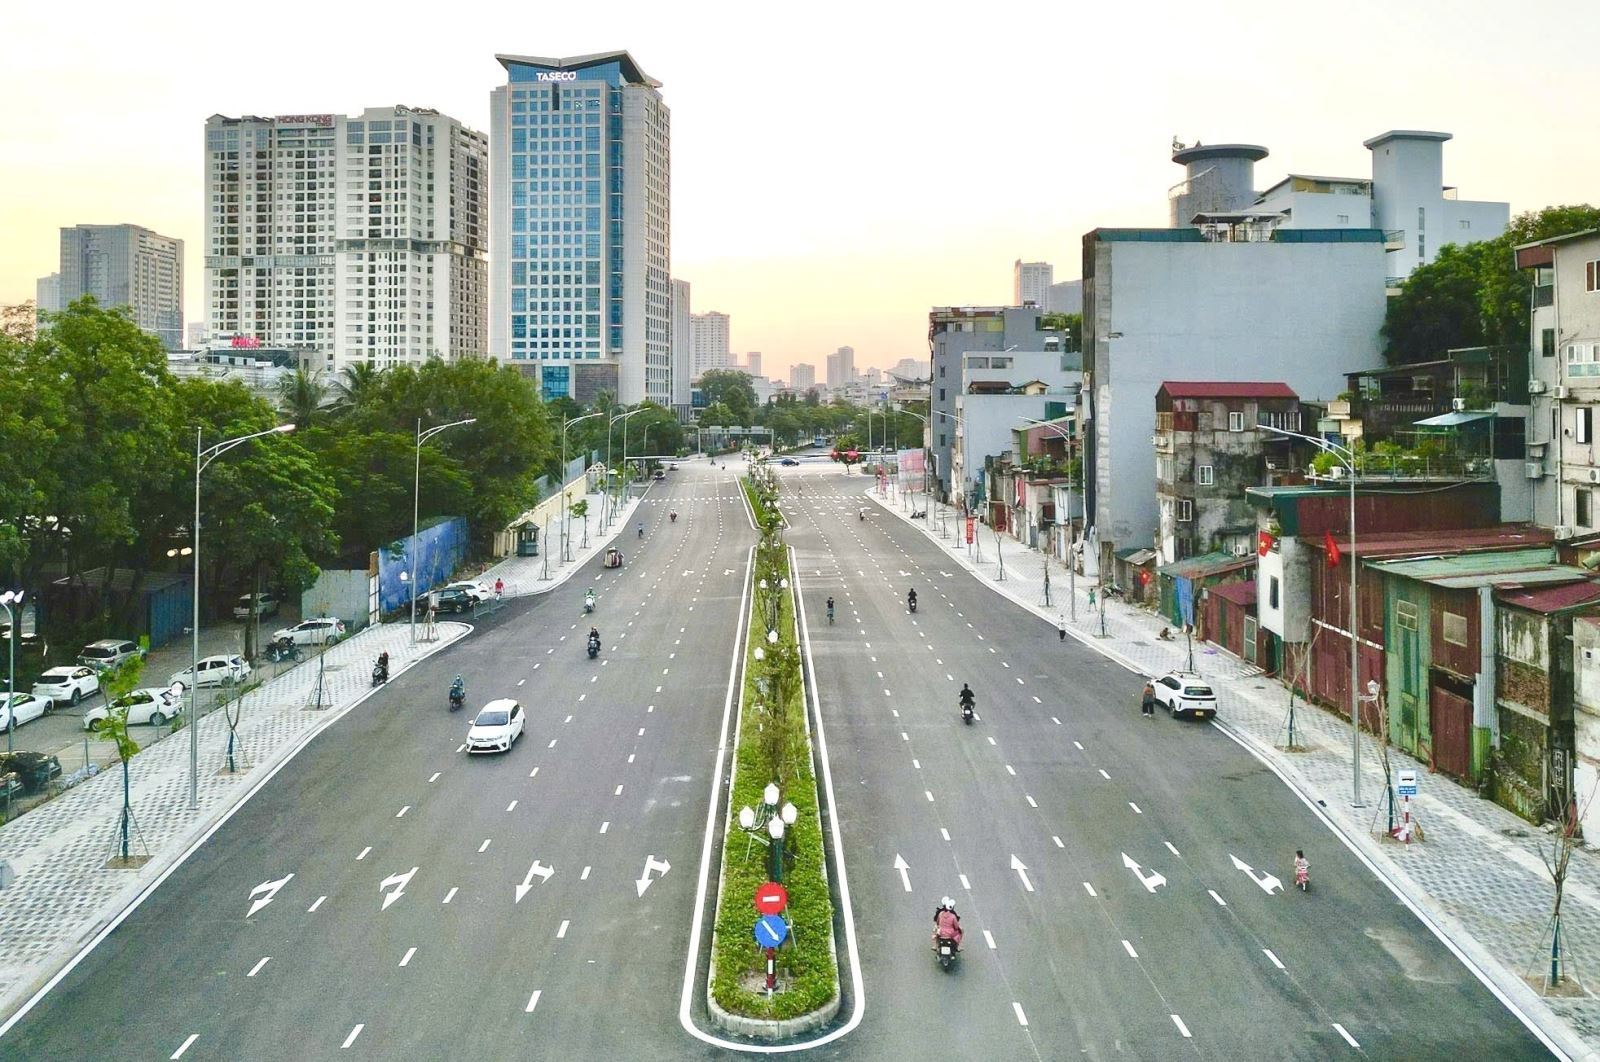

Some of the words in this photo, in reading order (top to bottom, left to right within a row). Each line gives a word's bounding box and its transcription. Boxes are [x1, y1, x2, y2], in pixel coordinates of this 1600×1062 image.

[536, 71, 577, 81] TASECO
[279, 115, 304, 123] HONG
[306, 114, 332, 123] KONG
